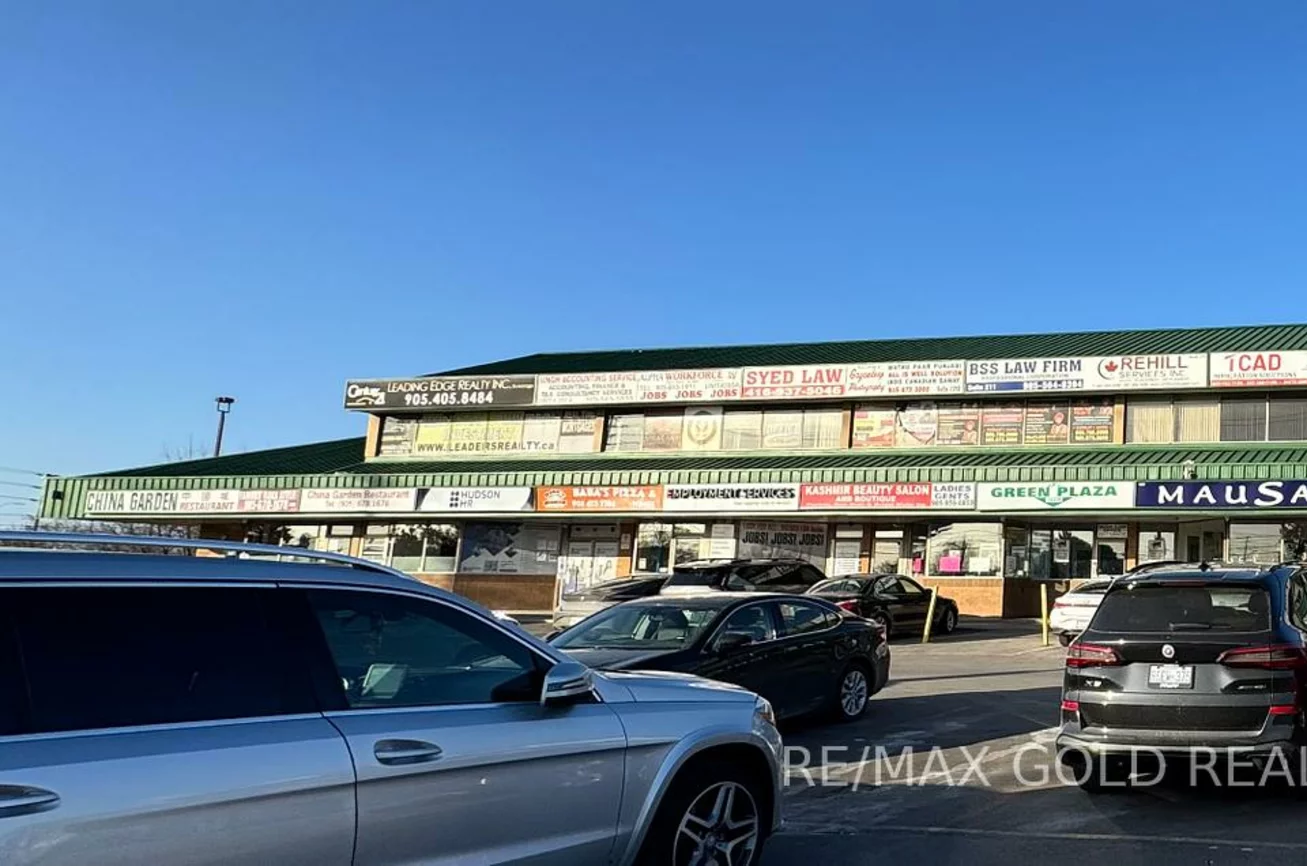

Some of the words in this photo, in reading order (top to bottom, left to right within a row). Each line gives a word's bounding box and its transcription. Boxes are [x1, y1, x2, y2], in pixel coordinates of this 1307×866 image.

[969, 363, 999, 375] BSS
[1004, 361, 1037, 374] LAW
[1043, 359, 1082, 372] FIRM
[1121, 355, 1188, 370] REHILL
[665, 371, 724, 380] WORKFORCE
[746, 370, 794, 384] SYED
[801, 368, 843, 383] LAW
[1119, 370, 1166, 378] SERVICES
[387, 381, 428, 393] LEADING
[430, 380, 457, 391] EDGE
[458, 379, 491, 391] REALTY
[404, 391, 494, 406] 905.405.8484
[640, 391, 668, 400] JOBS
[675, 390, 703, 399] JOBS
[710, 389, 738, 398] JOBS
[307, 491, 331, 499] China
[364, 490, 410, 499] Restaurant
[460, 490, 501, 499] HUDSON
[612, 487, 646, 498] PIZZA
[667, 488, 739, 499] EMPLOYMENT
[740, 487, 796, 499] SERVICES
[805, 485, 852, 495] KASHMIR
[853, 485, 893, 495] BEAUTY
[896, 485, 929, 495] SALON
[991, 487, 1050, 498] GREEN
[1057, 485, 1117, 497] PLAZA
[86, 490, 125, 512] CHINA
[129, 491, 178, 512] GARDEN
[179, 501, 235, 511] RESTAURANT
